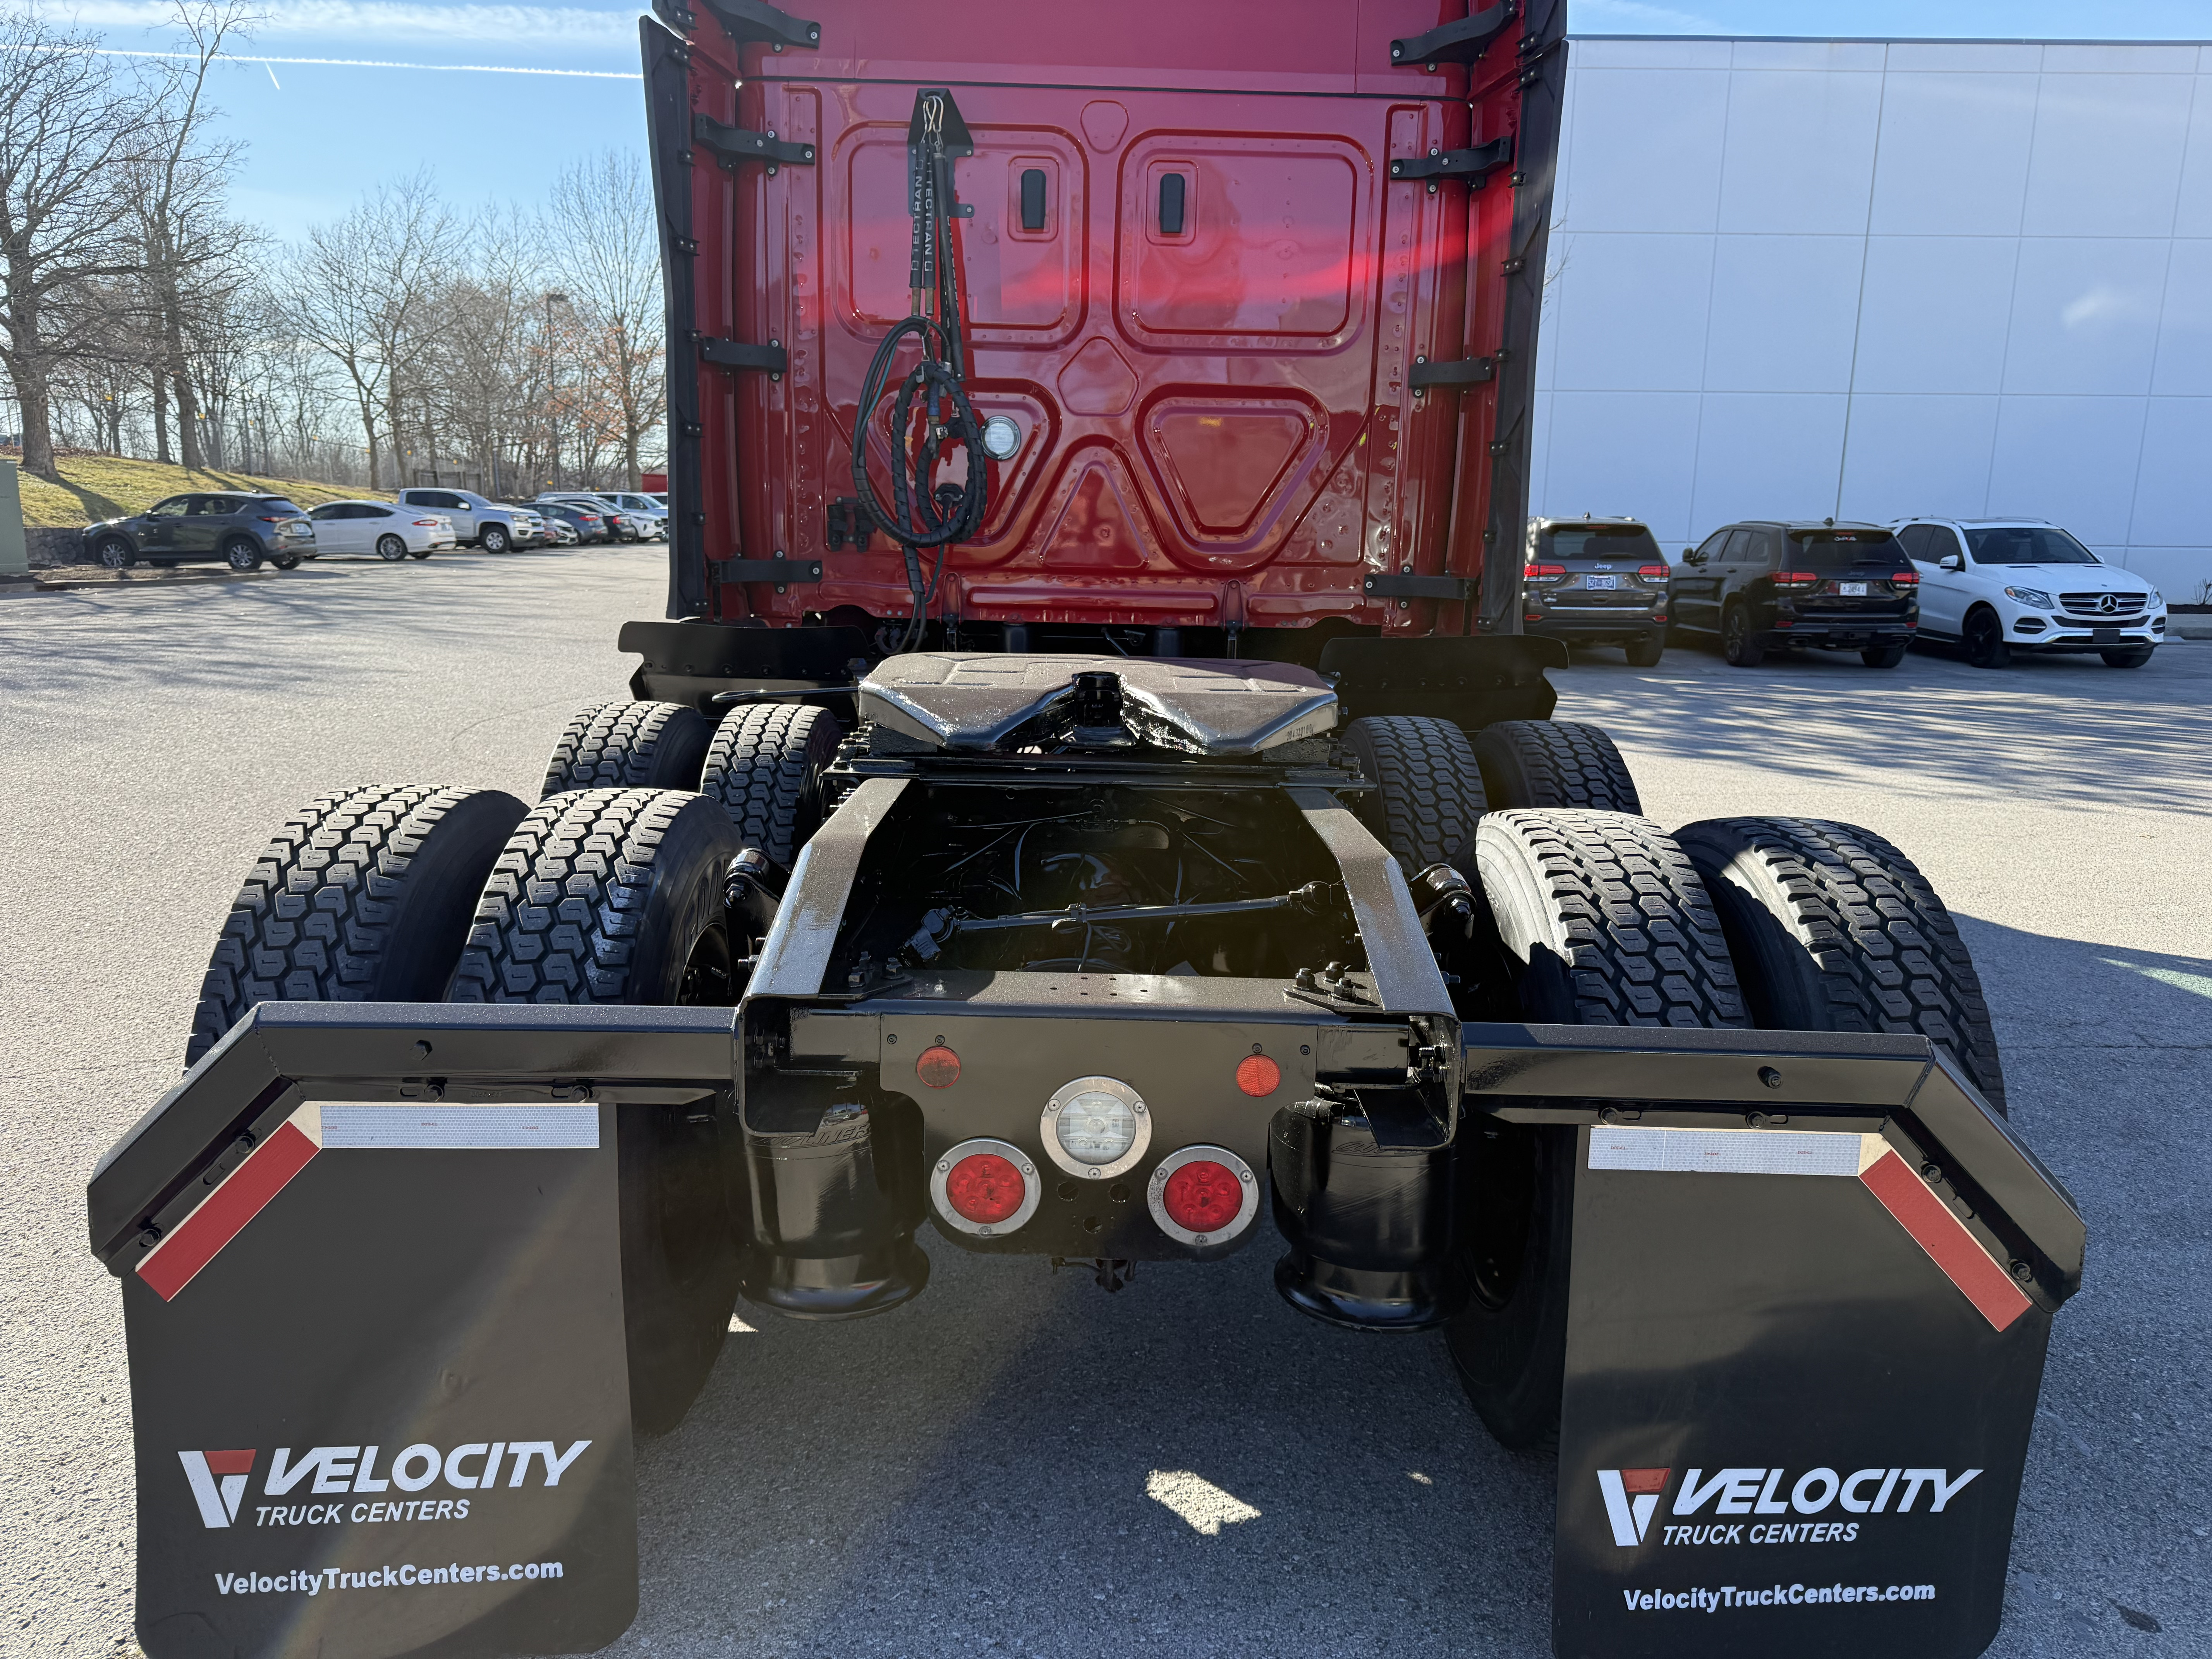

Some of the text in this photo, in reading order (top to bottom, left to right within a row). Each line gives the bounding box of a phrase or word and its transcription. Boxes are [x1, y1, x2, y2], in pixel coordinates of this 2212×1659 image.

[912, 176, 922, 255] TECTRAN
[264, 1440, 592, 1495] VELOCITY
[1672, 1468, 1984, 1515] VELOCITY
[256, 1499, 471, 1527] TRUCK CENTERS
[1663, 1523, 1860, 1546] TRUCK CENTERS
[215, 1562, 563, 1596] VelocityTruckCenters.com
[1623, 1583, 1935, 1613] VelocityTruckCenters.com
